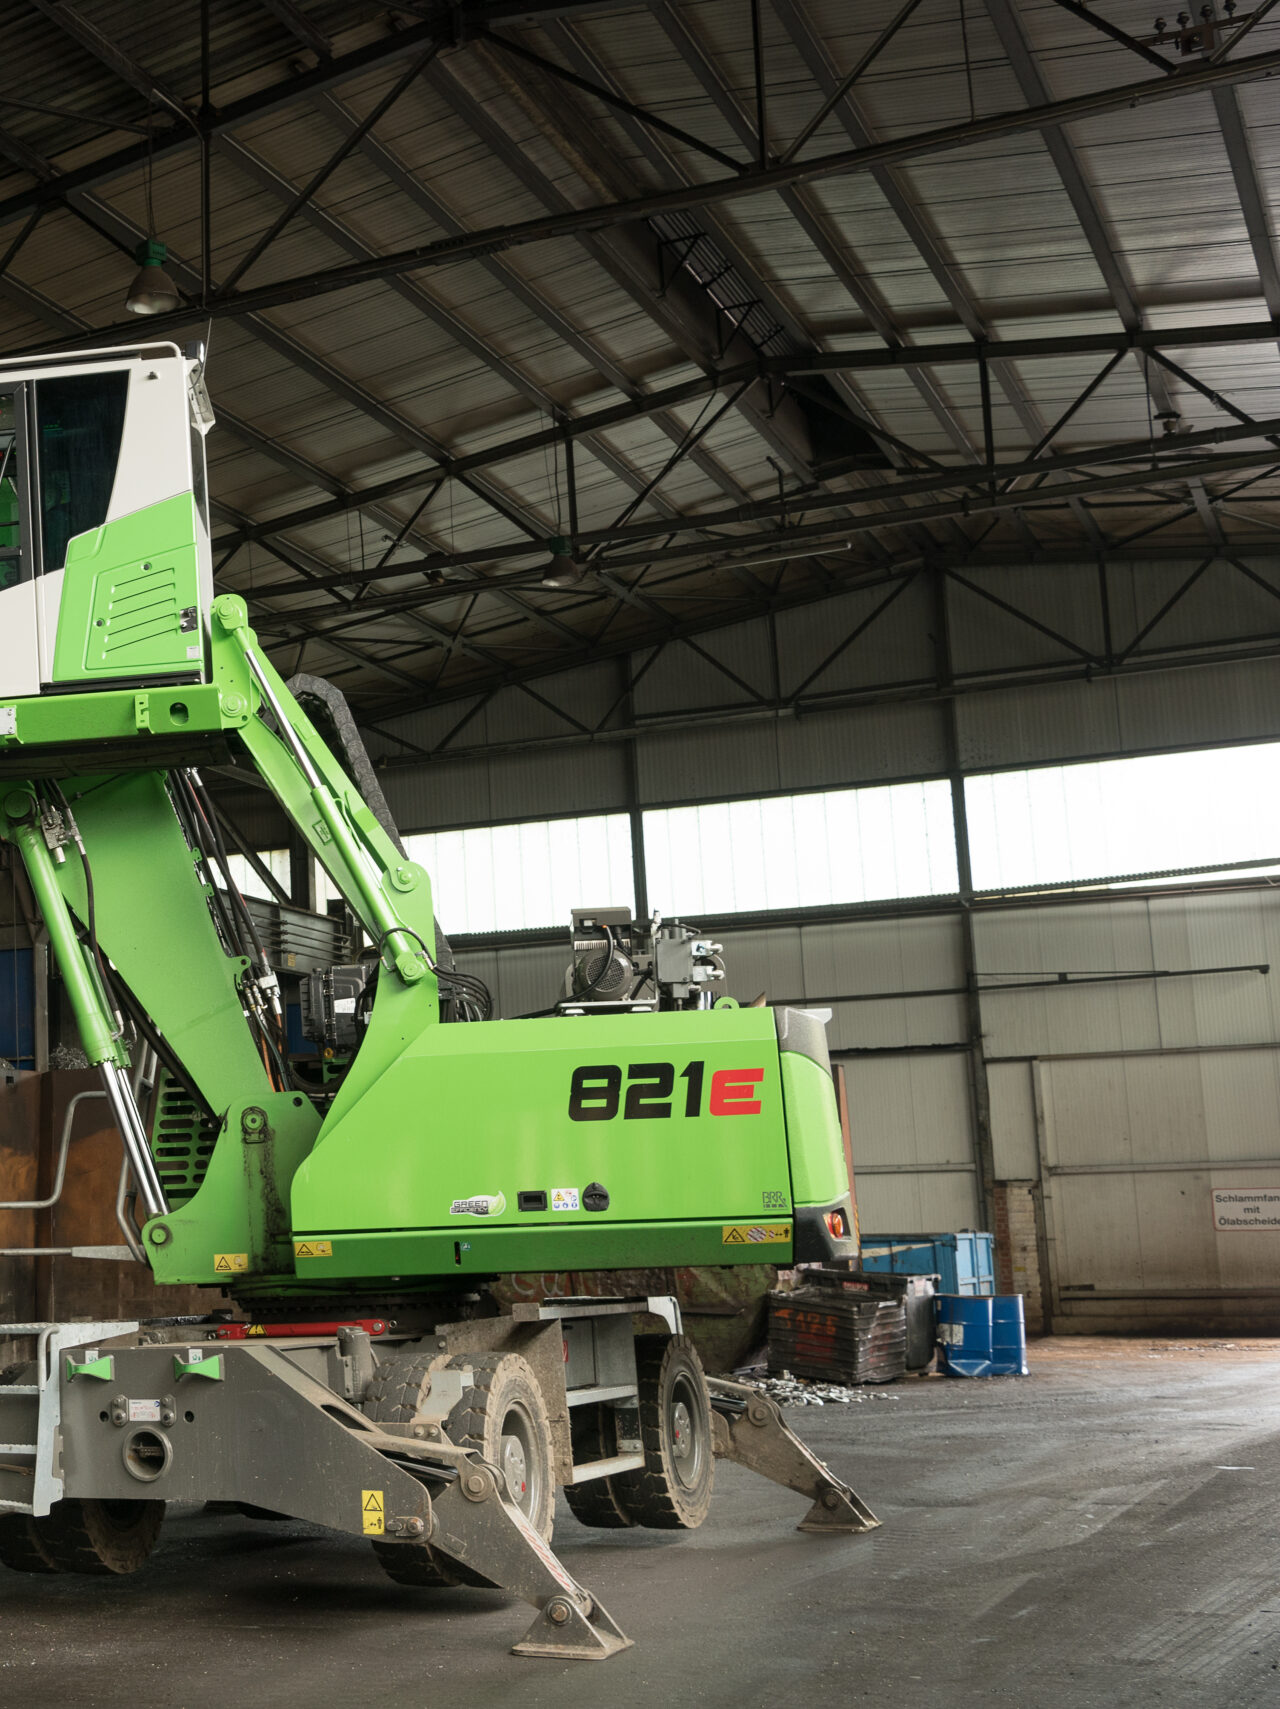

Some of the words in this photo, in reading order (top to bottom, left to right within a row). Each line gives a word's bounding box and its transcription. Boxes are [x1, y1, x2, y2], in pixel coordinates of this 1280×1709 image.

[568, 1061, 764, 1122] 821E
[454, 1200, 489, 1208] GREEN
[1243, 1205, 1260, 1214] mit
